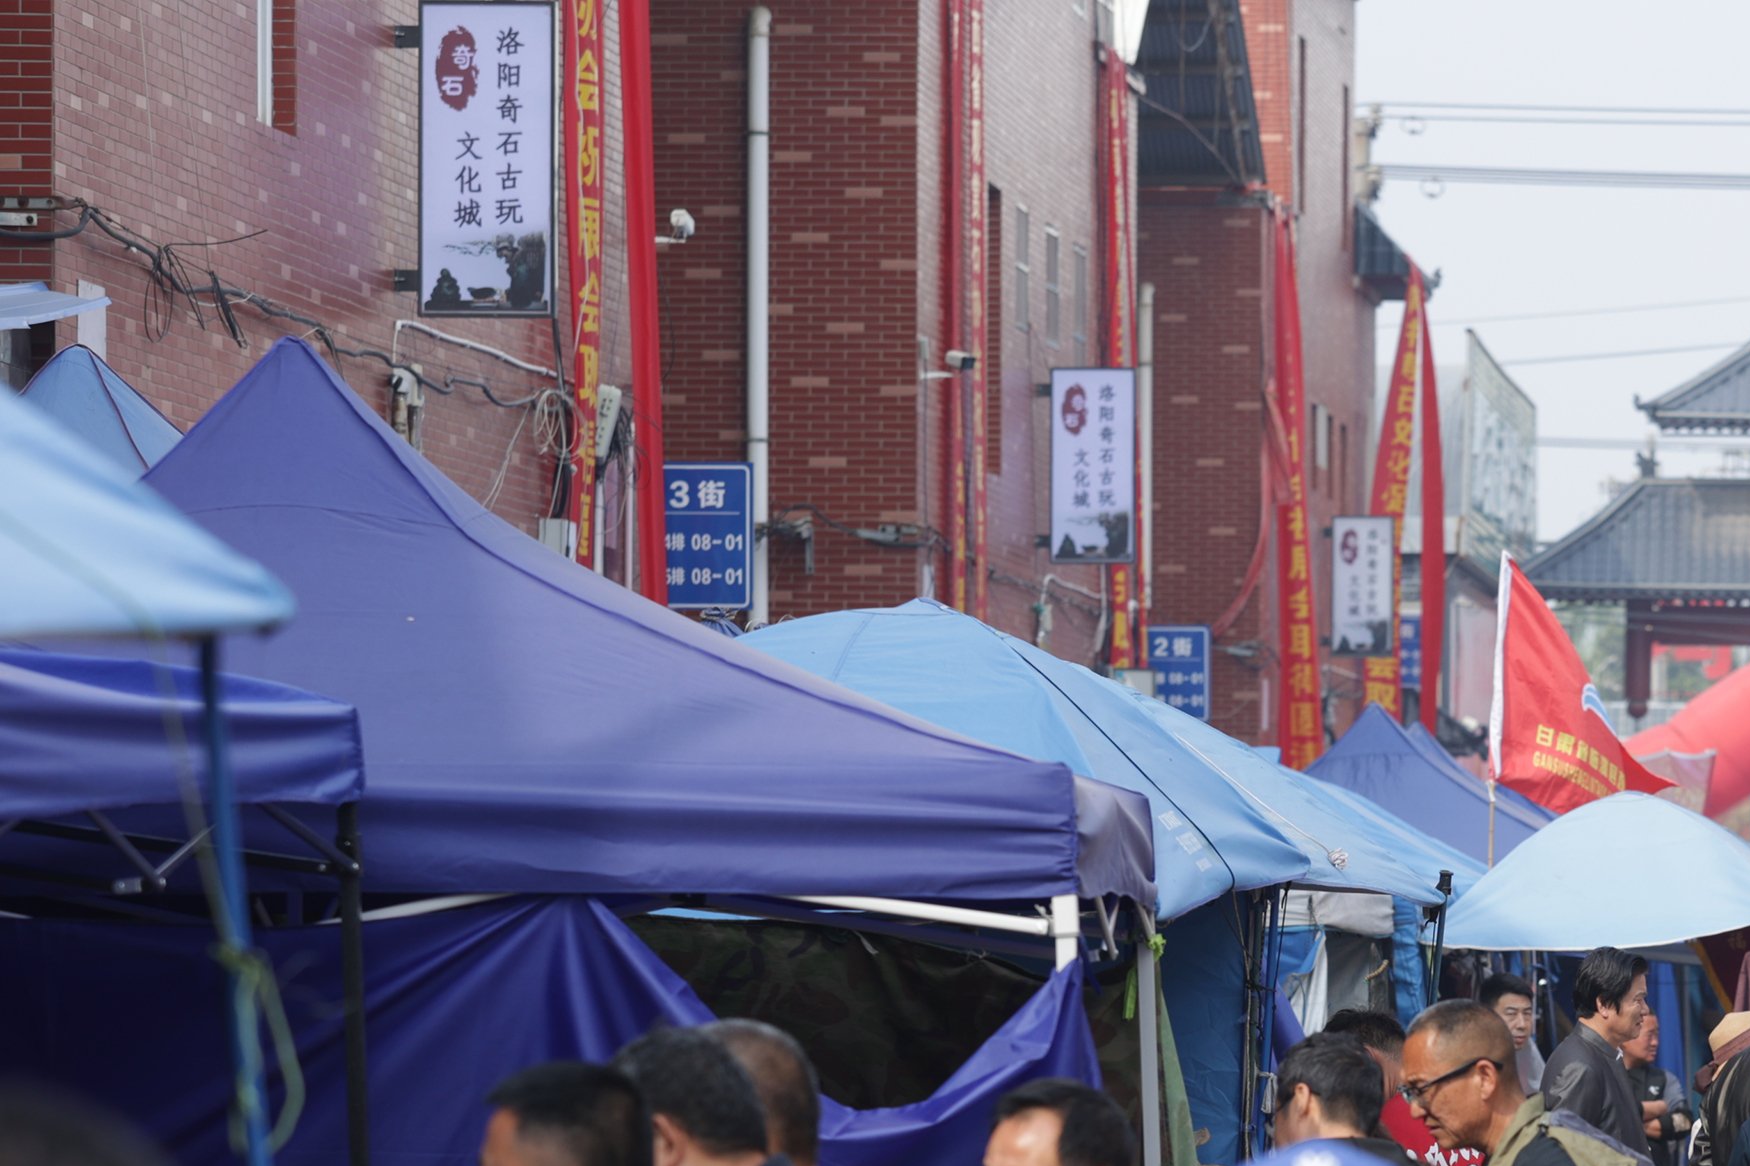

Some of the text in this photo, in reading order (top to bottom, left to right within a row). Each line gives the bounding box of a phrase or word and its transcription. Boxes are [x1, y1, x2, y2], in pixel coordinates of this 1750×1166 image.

[441, 45, 473, 96] 奇石
[495, 26, 524, 225] 洛阳奇石古玩
[453, 131, 482, 228] 文化城
[1099, 385, 1115, 507] 洛阳奇石古玩
[669, 480, 726, 509] 3街
[1072, 449, 1090, 508] 文化城
[691, 533, 743, 551] 08-01
[691, 567, 743, 585] 08-01
